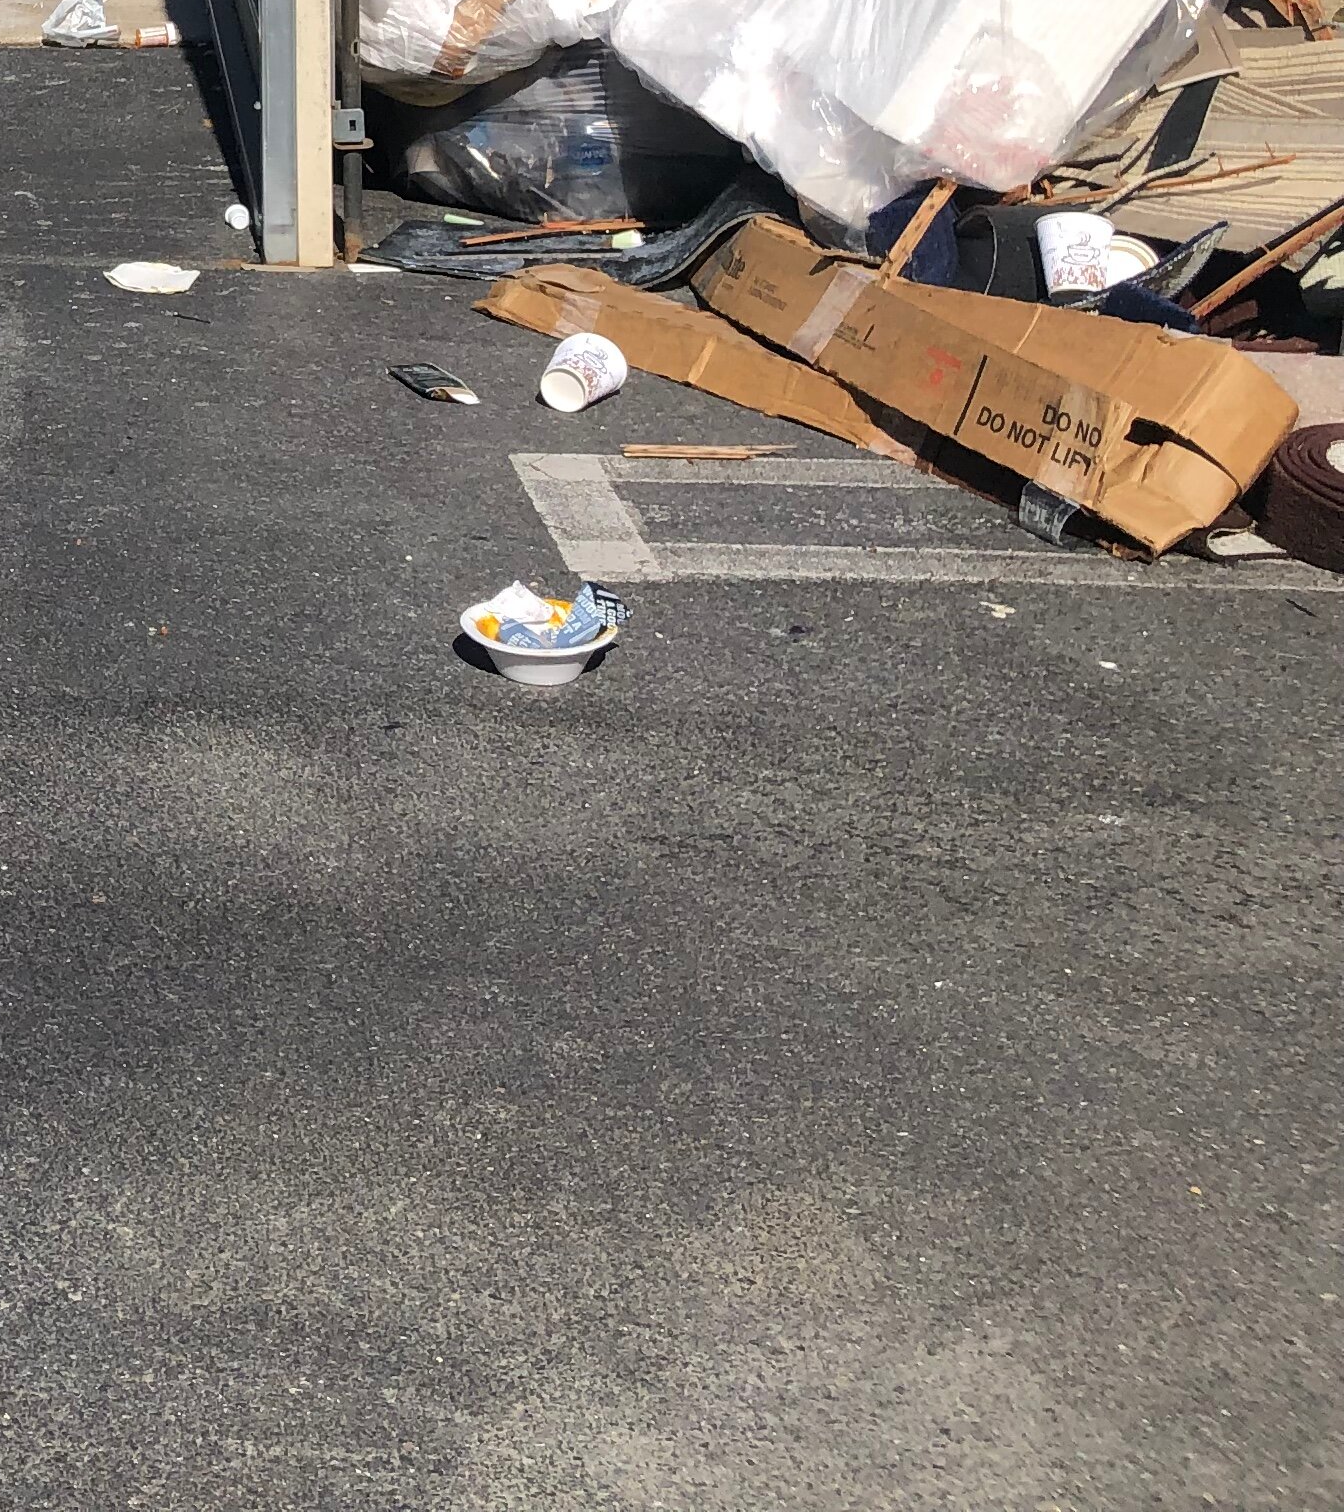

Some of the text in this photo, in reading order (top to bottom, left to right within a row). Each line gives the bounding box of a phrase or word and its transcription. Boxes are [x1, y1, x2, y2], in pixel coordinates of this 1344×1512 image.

[976, 405, 1005, 435] DO
[1007, 420, 1051, 449] NOT
[1042, 404, 1103, 448] DO NO
